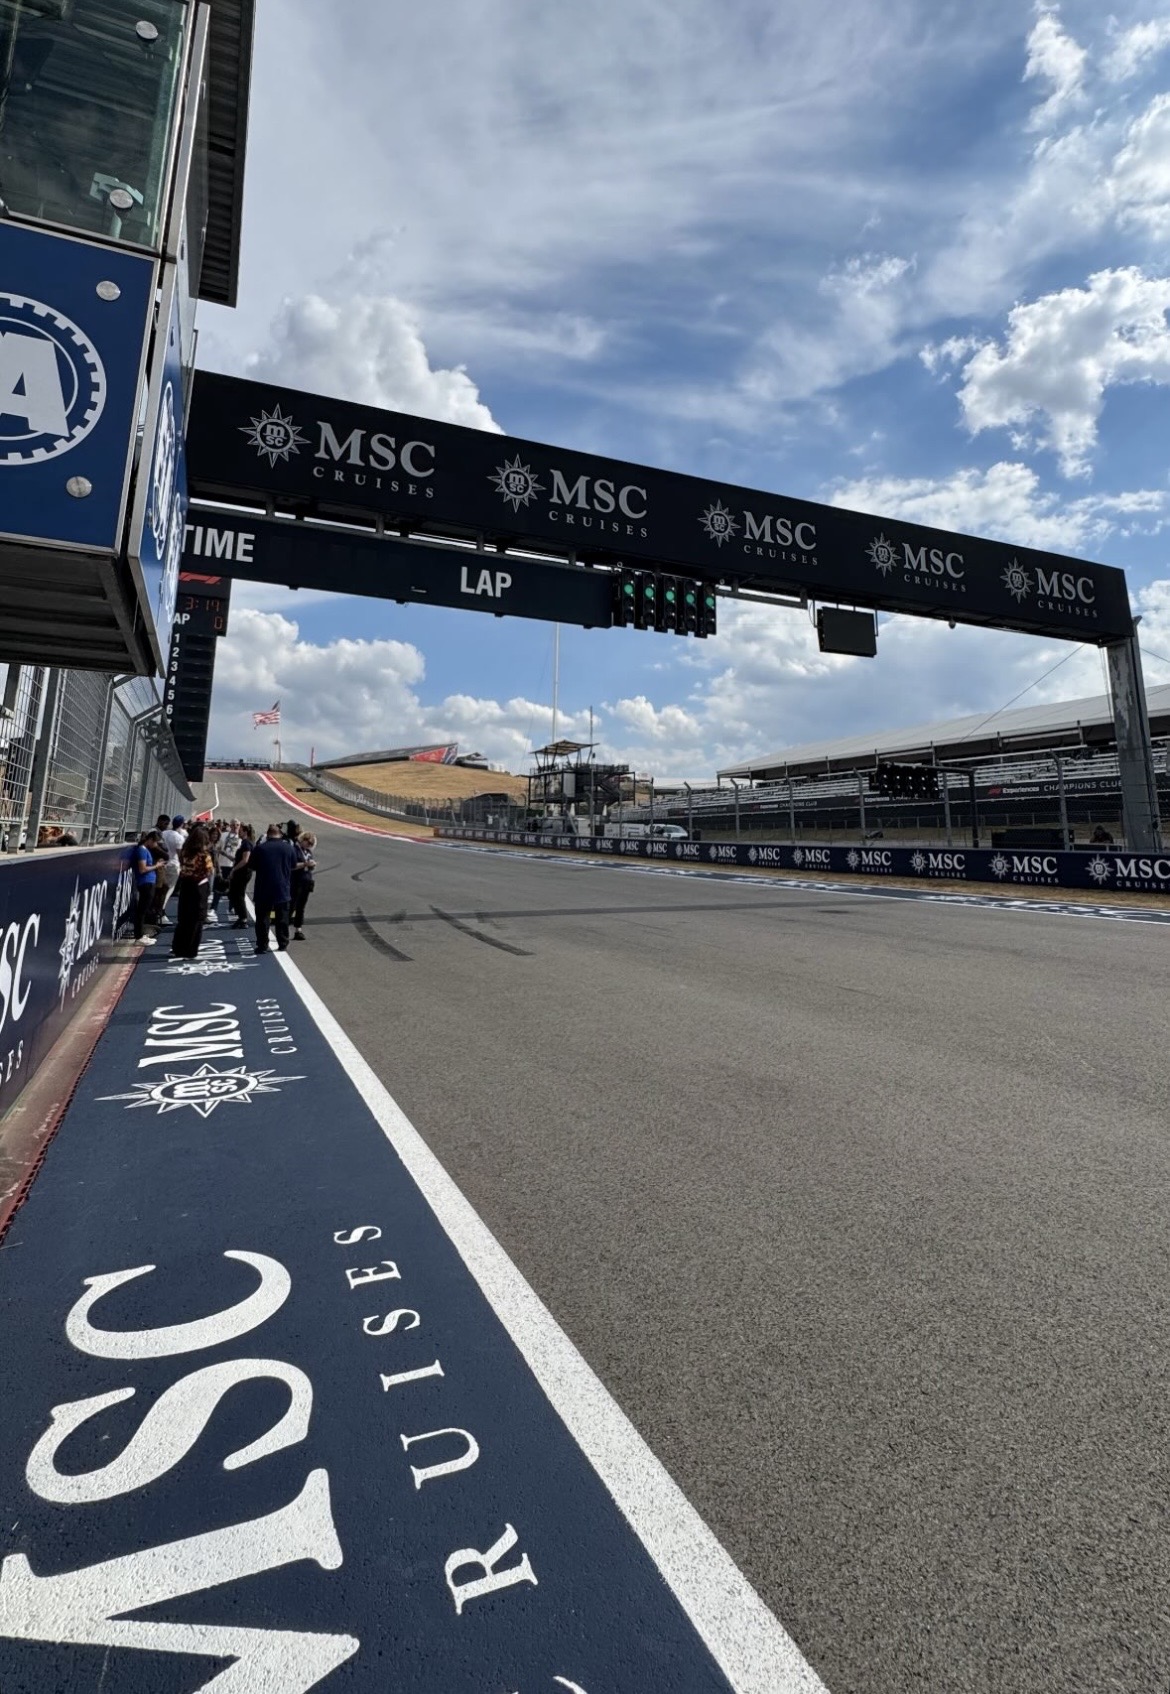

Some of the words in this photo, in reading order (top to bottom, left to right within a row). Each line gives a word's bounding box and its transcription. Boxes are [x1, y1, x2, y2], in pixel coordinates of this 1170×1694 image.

[314, 420, 435, 477] MSC
[313, 466, 434, 498] CRUISES
[549, 469, 647, 519] MSC
[548, 510, 648, 538] CRUISES
[742, 510, 816, 550] MSC
[182, 524, 255, 562] TIME
[743, 544, 818, 565] CRUISES
[902, 542, 965, 578] MSC
[460, 566, 512, 598] LAP
[904, 574, 966, 592] CRUISES
[1035, 567, 1095, 604] MSC
[173, 612, 190, 624] AP
[1038, 600, 1098, 618] CRUISES
[174, 633, 180, 643] 1
[172, 647, 180, 657] 2
[171, 661, 178, 671] 3
[169, 675, 176, 685] 4
[167, 690, 175, 700] 5
[166, 704, 173, 714] 6
[1002, 786, 1040, 794] Experiences
[626, 841, 639, 851] MSC
[652, 843, 667, 853] MSC
[683, 844, 699, 856] MSC
[718, 845, 736, 858] MSC
[758, 847, 780, 861] MSC
[805, 849, 831, 863] MSC
[861, 851, 892, 866] MSC
[928, 852, 965, 870] MSC
[1012, 856, 1057, 874] MSC
[929, 870, 966, 878] CRUISES
[1114, 858, 1170, 880] MSC
[1013, 875, 1059, 883] CRUISES
[1116, 880, 1170, 889] CRUISE
[76, 879, 107, 960] MSC
[0, 912, 41, 1034] SC
[137, 1002, 244, 1068] MSC
[256, 998, 298, 1054] CRUISES
[333, 1225, 587, 1694] RUISES
[0, 1250, 360, 1694] MSC
